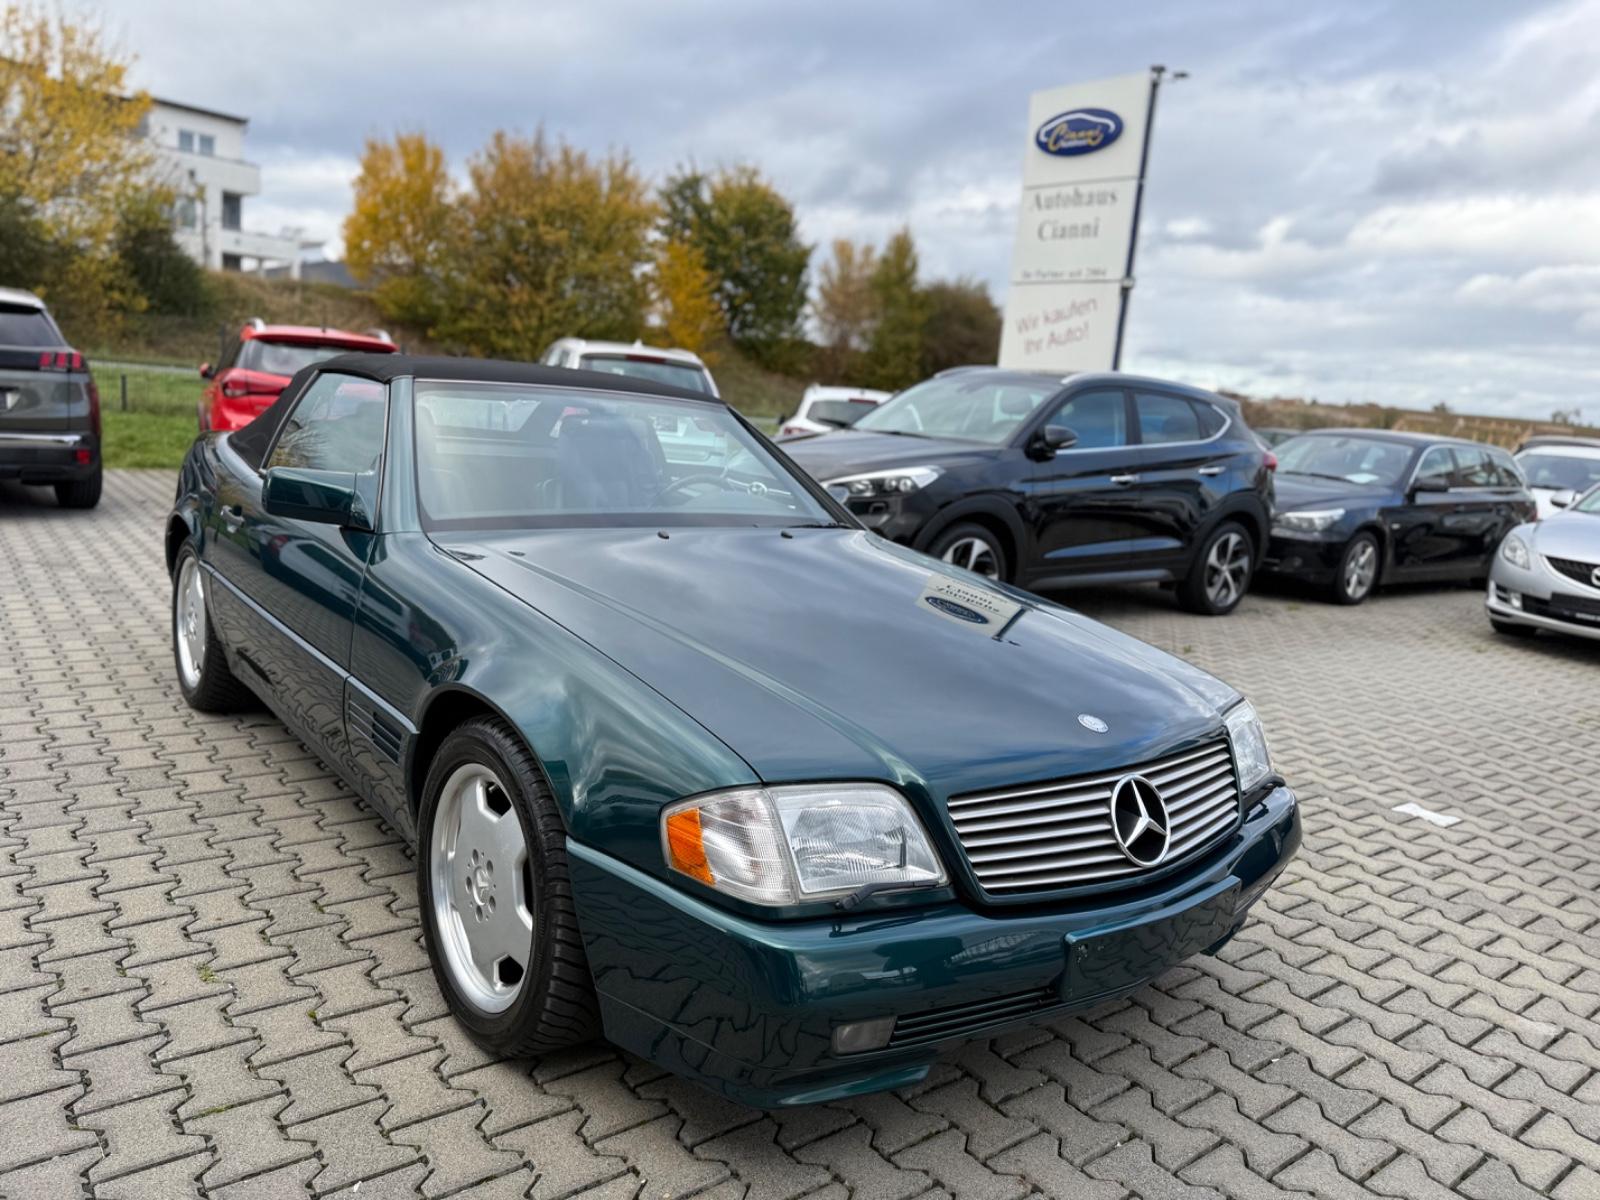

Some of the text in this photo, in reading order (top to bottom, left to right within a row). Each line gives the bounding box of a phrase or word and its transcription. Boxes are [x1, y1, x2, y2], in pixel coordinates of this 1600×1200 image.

[1028, 187, 1117, 212] Autohaus
[1037, 216, 1101, 242] Cianni
[1016, 298, 1098, 335] Wir kaufen
[1024, 321, 1090, 355] Ihr Auto!
